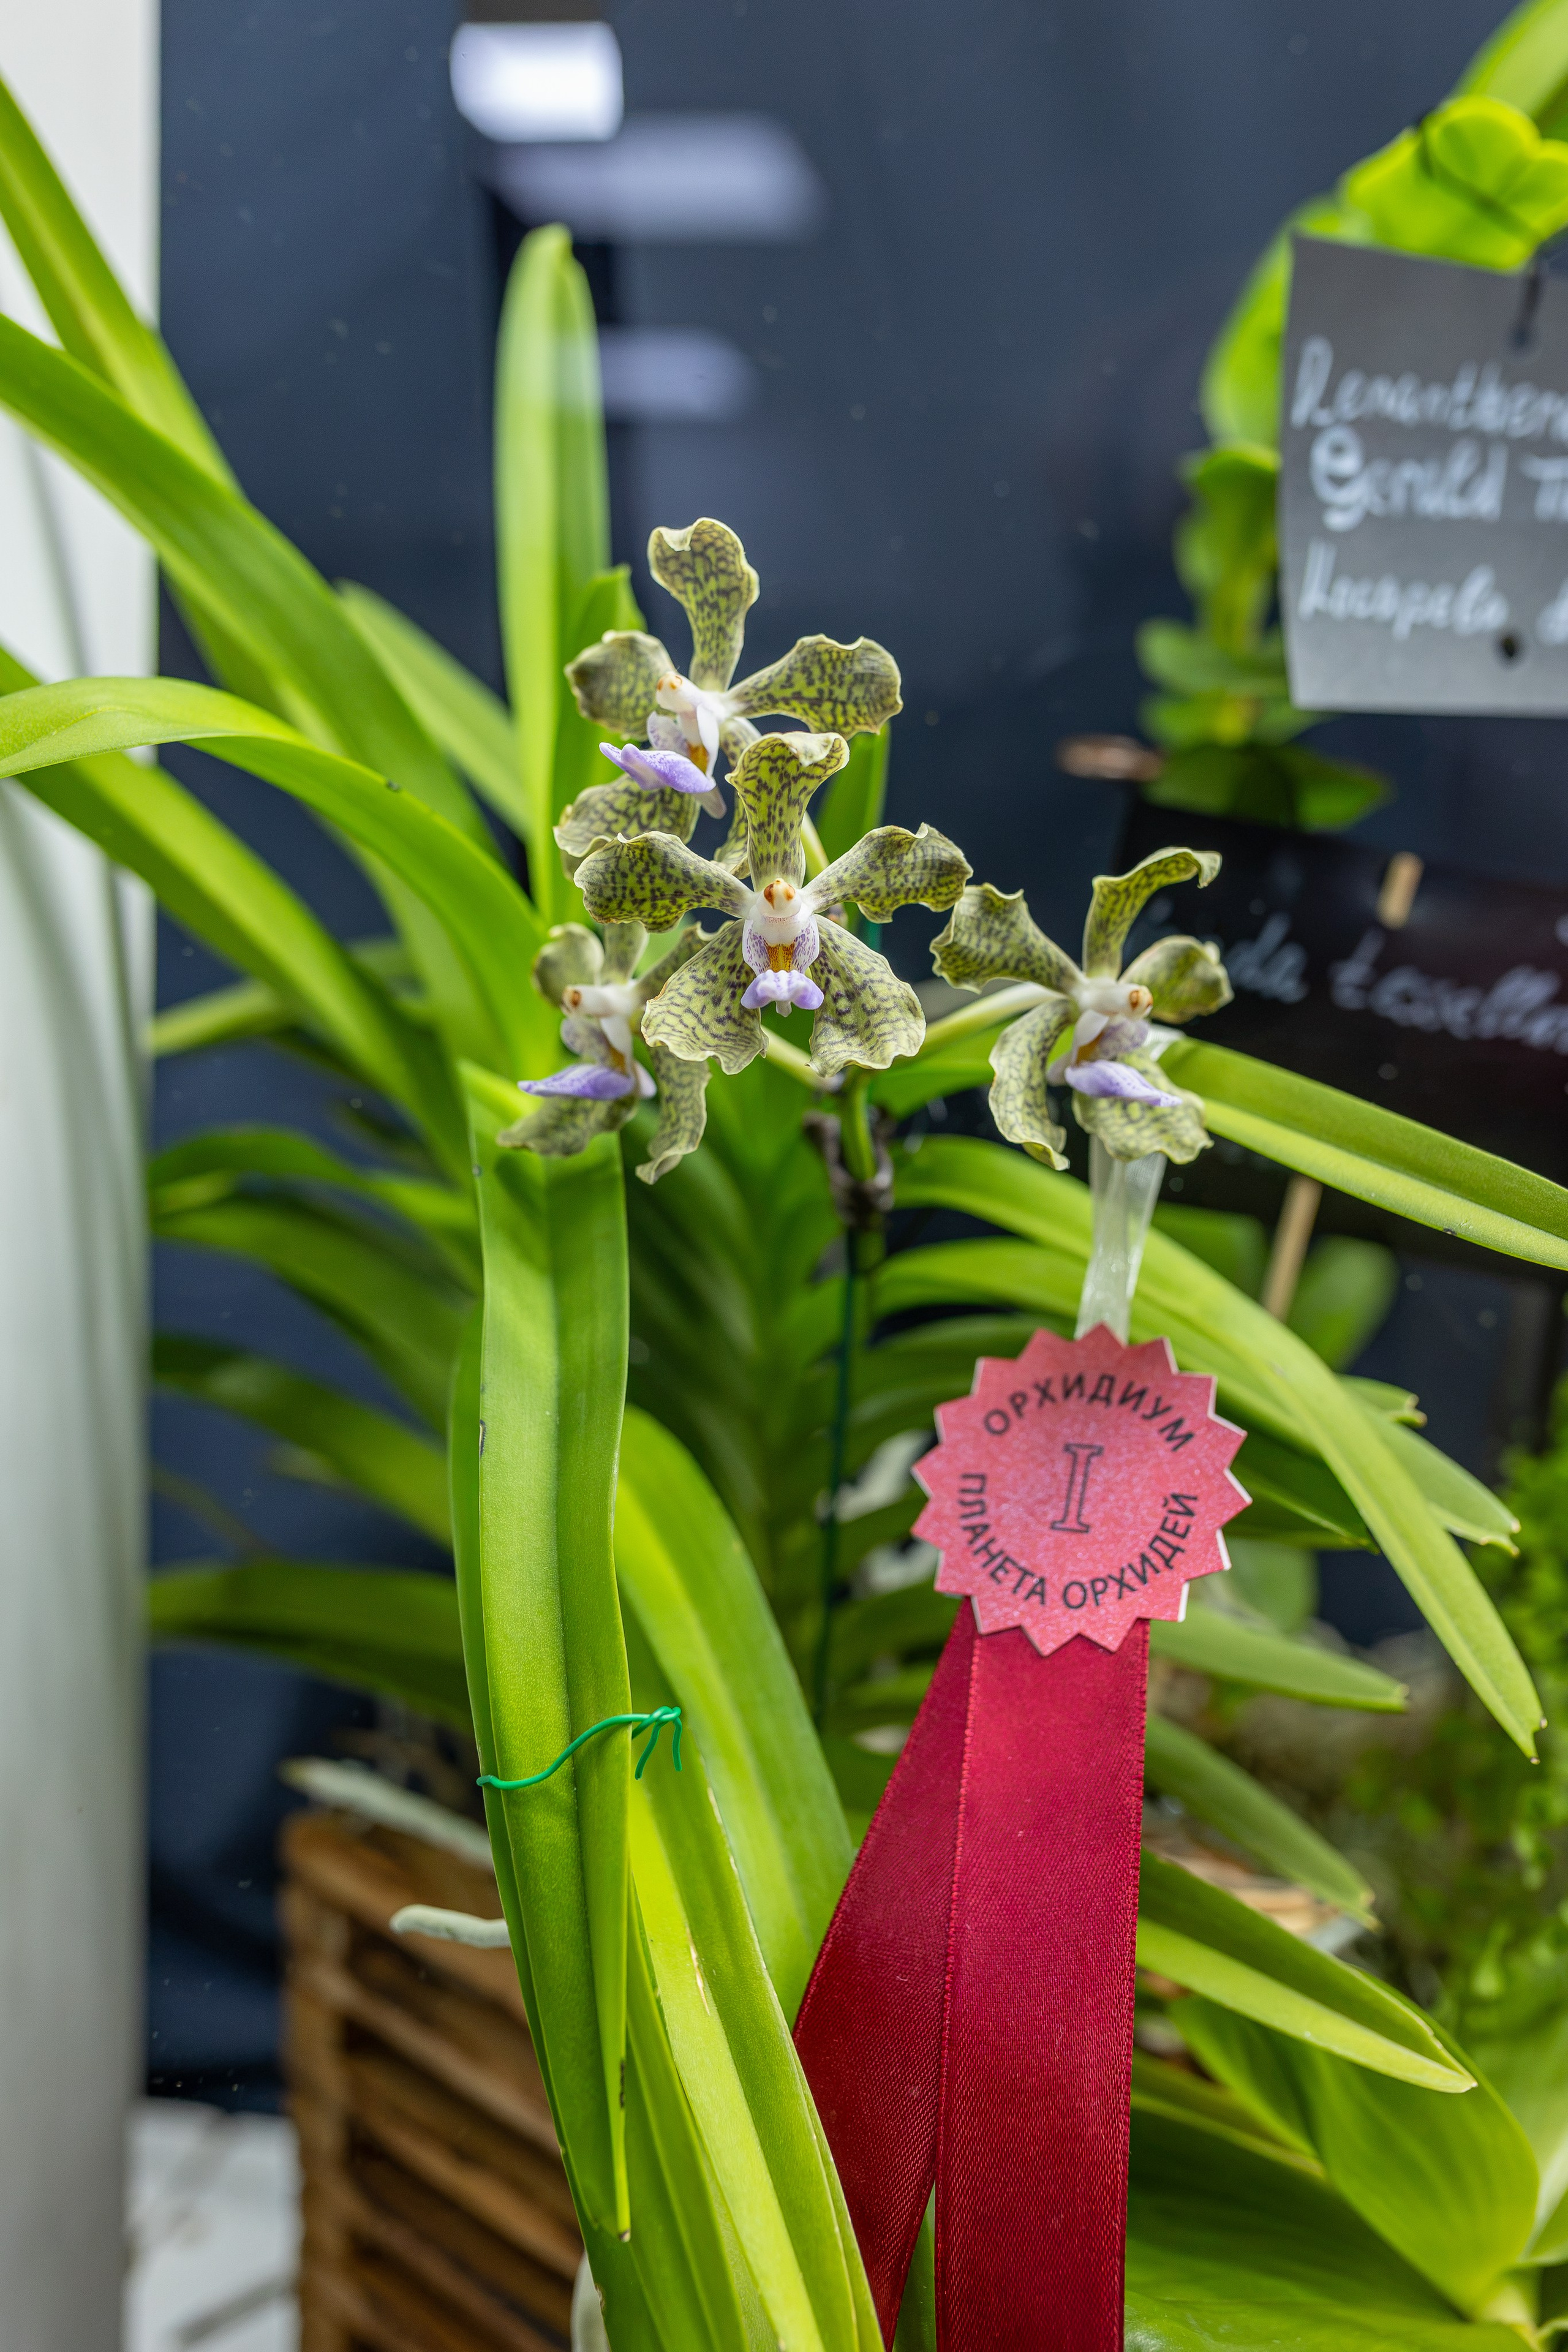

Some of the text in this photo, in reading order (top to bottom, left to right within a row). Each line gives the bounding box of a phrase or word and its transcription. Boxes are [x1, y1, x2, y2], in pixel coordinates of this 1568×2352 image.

[983, 1374, 1195, 1452] ОРХИДИУМ
[957, 1473, 1199, 1610] ПЛАНЕТА ОРХИДЕЙ
